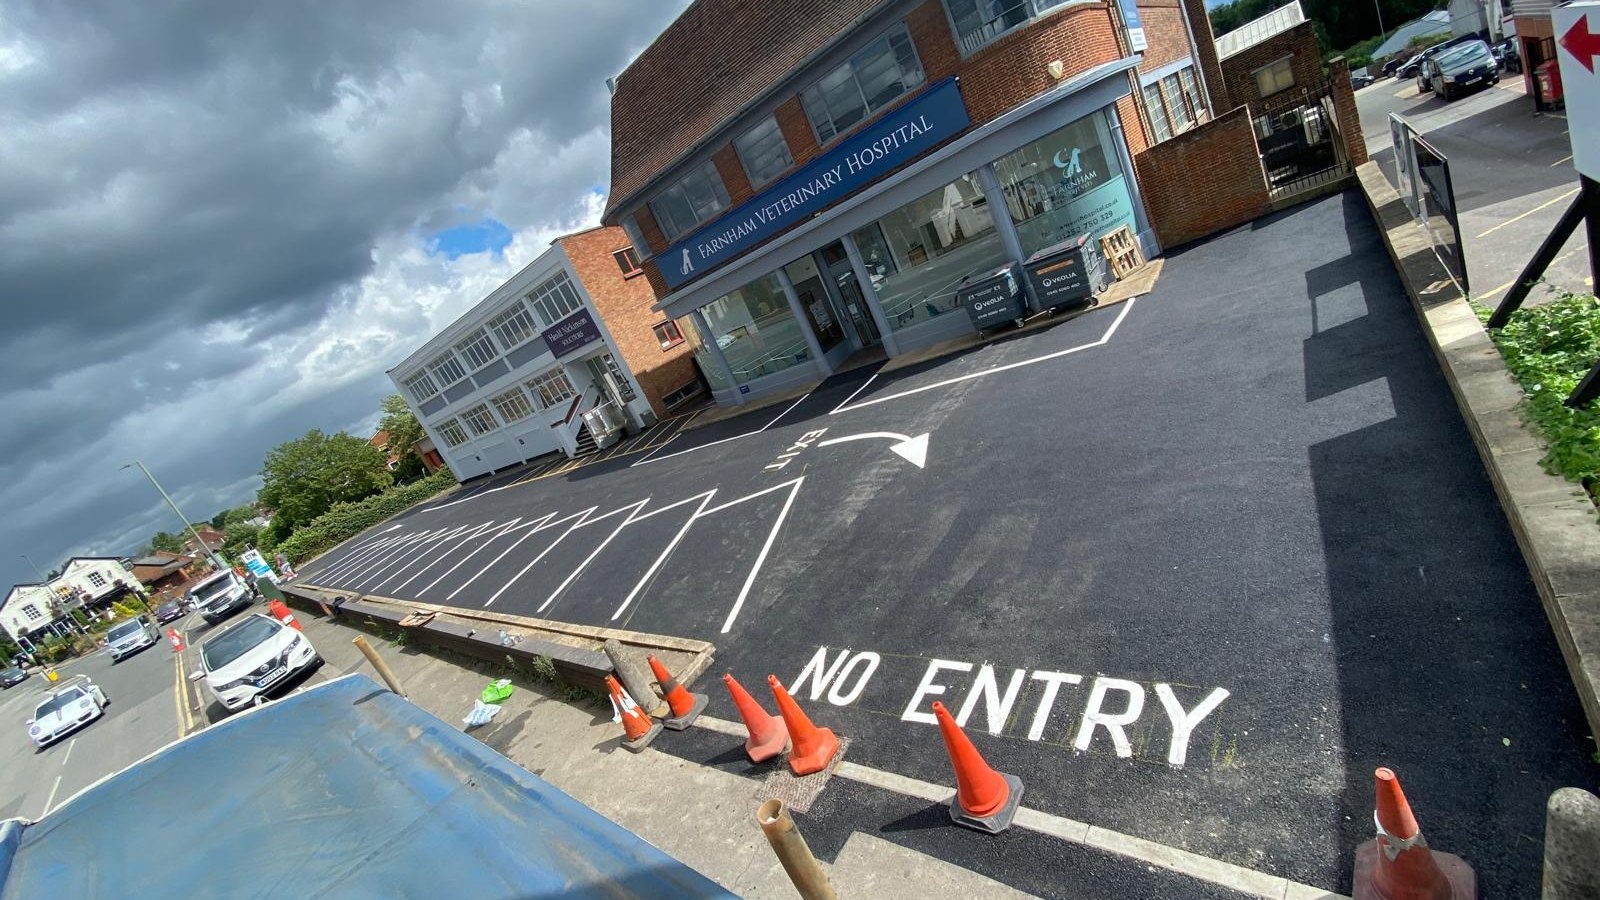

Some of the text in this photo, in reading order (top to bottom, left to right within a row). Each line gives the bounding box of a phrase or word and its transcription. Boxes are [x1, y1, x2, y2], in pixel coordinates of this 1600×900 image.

[697, 115, 934, 259] FARNHAM VETERINARY HOSPITAL
[1053, 170, 1097, 197] FARNHAM
[1083, 217, 1099, 231] 750
[1100, 210, 1114, 223] 329
[1051, 271, 1077, 284] VEOLIA
[982, 295, 1004, 307] VEOLIA
[764, 427, 829, 470] EXIT
[788, 645, 1231, 766] NO ENTRY
